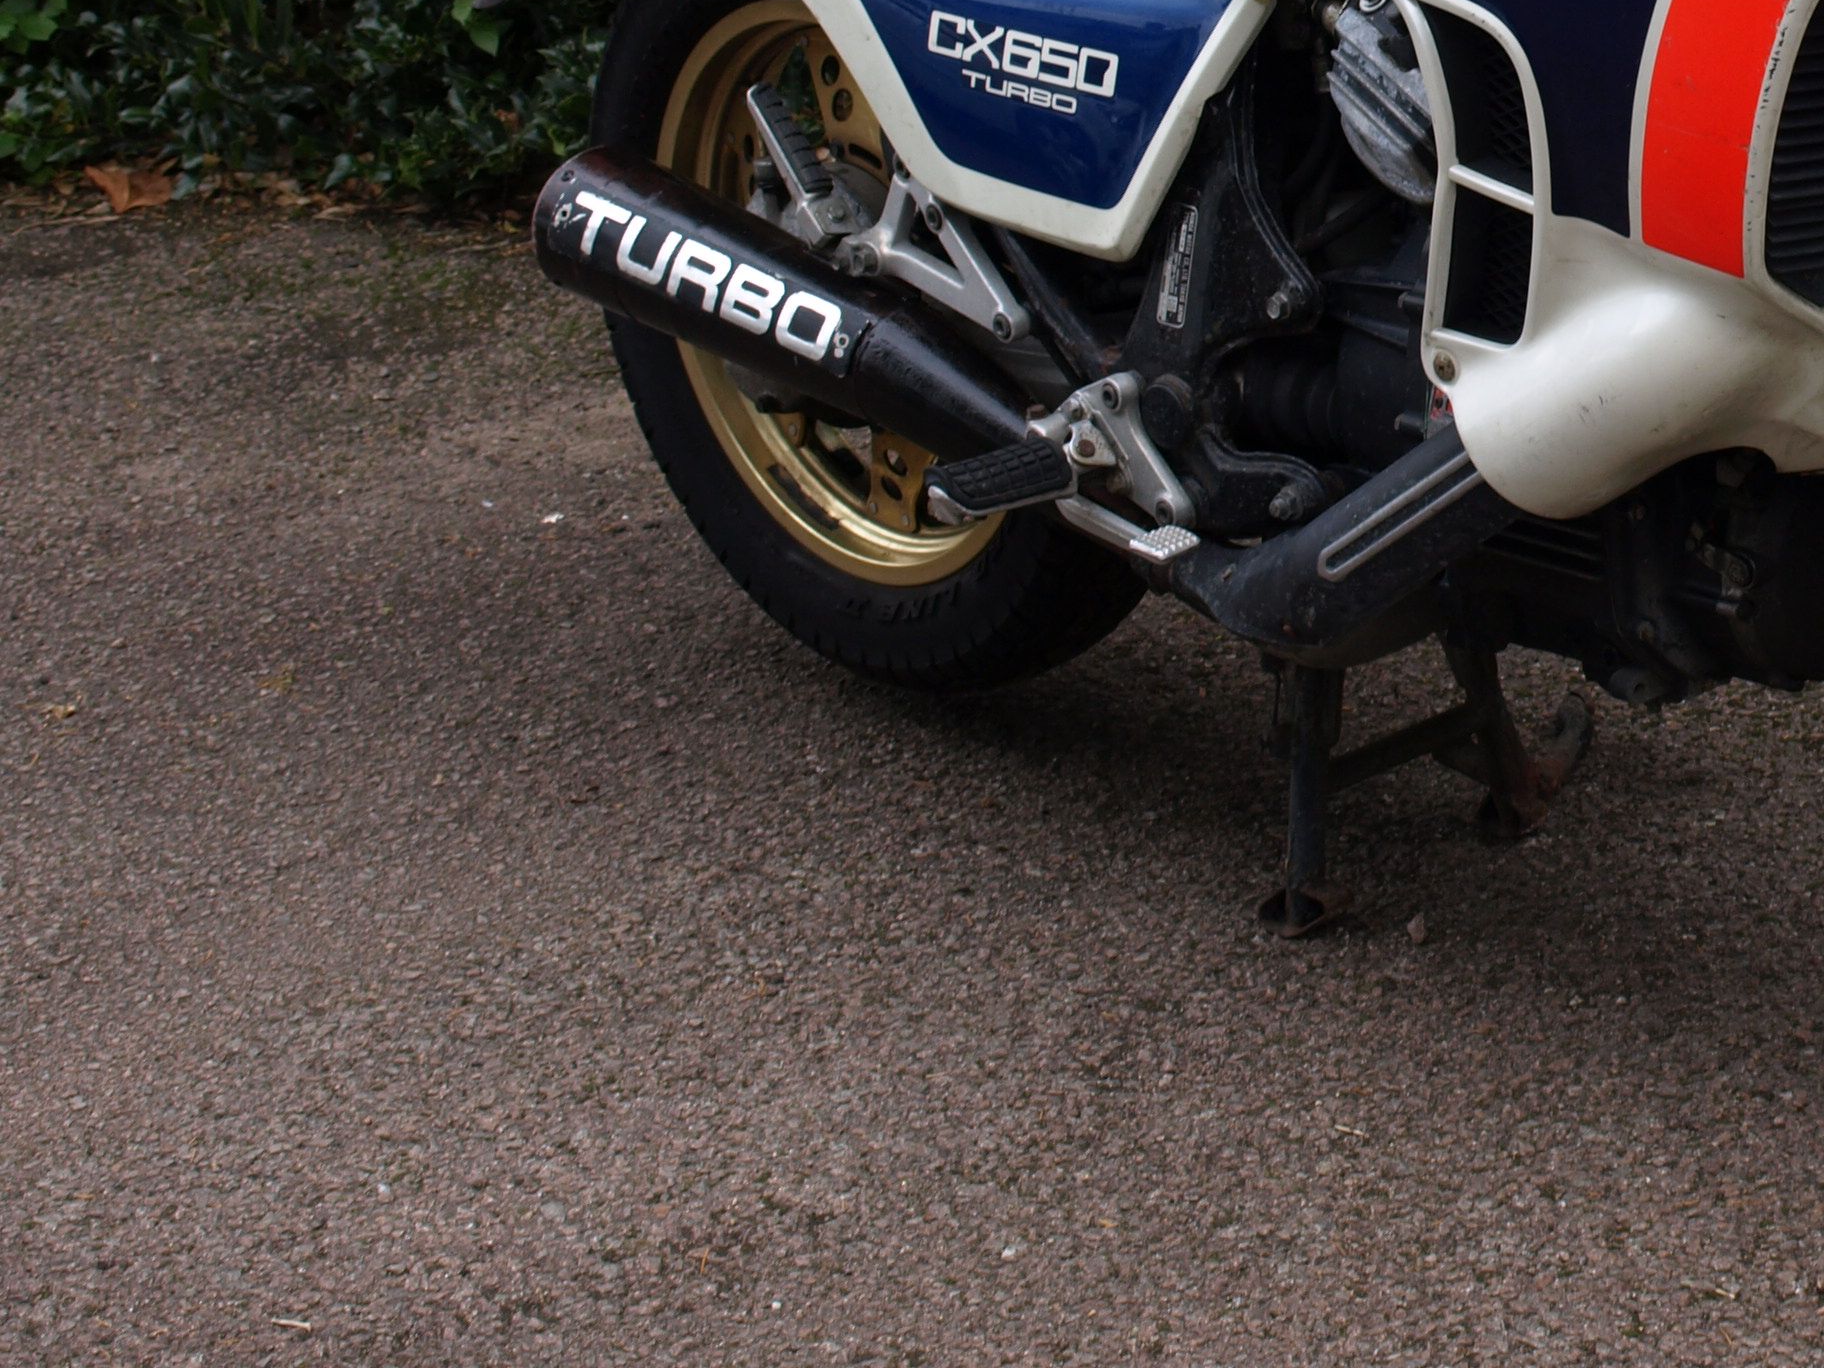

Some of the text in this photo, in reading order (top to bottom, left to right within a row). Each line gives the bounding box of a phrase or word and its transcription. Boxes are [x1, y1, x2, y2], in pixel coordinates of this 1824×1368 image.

[927, 9, 1120, 98] CX650
[961, 68, 1078, 115] TURBO
[575, 190, 842, 362] TURBO
